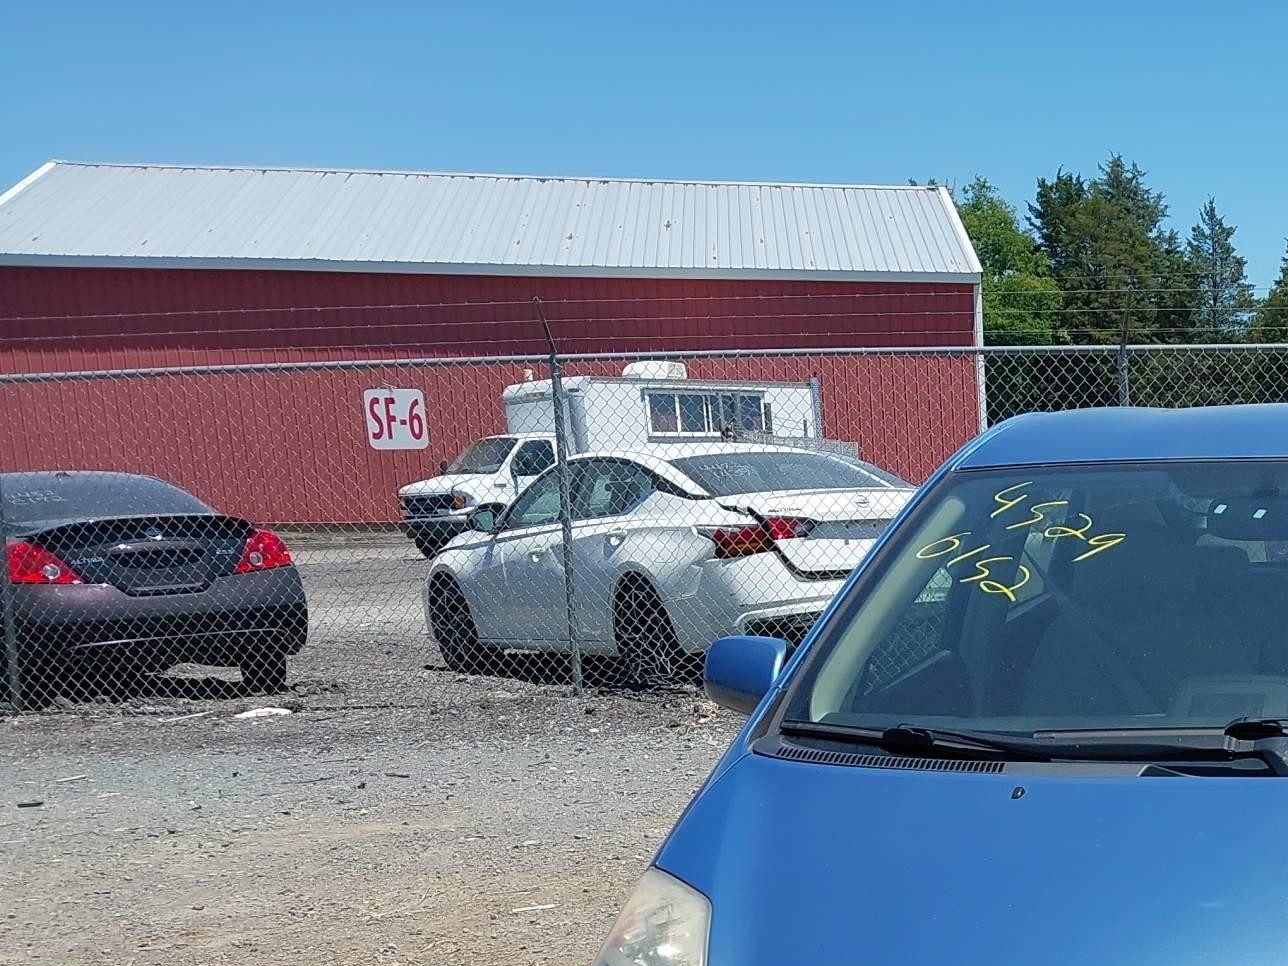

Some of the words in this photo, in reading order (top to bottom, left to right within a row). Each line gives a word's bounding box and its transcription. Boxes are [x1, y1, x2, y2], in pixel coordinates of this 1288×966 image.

[369, 397, 424, 440] SF-6
[990, 481, 1126, 562] 4529
[916, 532, 1031, 602] 0152
